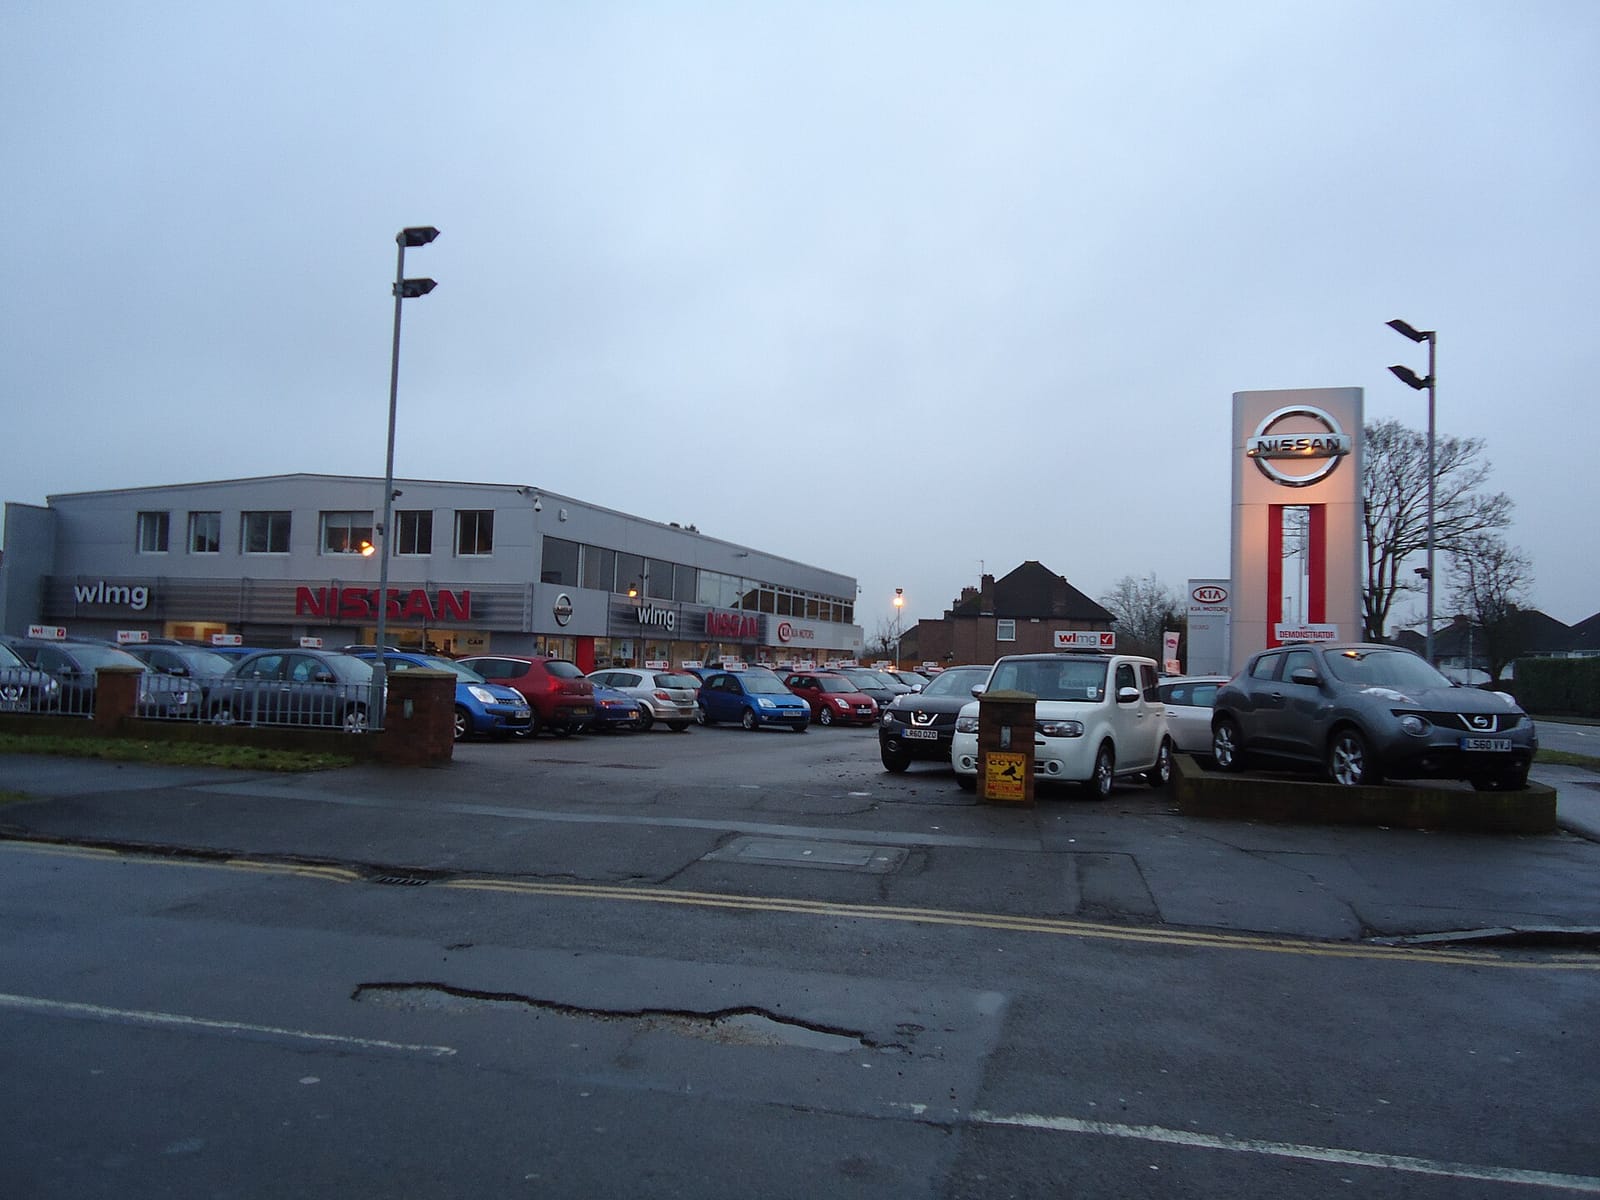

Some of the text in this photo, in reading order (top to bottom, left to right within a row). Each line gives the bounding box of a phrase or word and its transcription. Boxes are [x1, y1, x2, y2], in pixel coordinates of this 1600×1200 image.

[1257, 437, 1341, 451] NISSAN
[74, 581, 149, 610] wlmg
[296, 586, 471, 620] NISSAN
[1199, 590, 1221, 599] KIA
[637, 604, 675, 632] wlmg
[707, 612, 760, 637] NISSAN
[1059, 633, 1097, 646] wlmg
